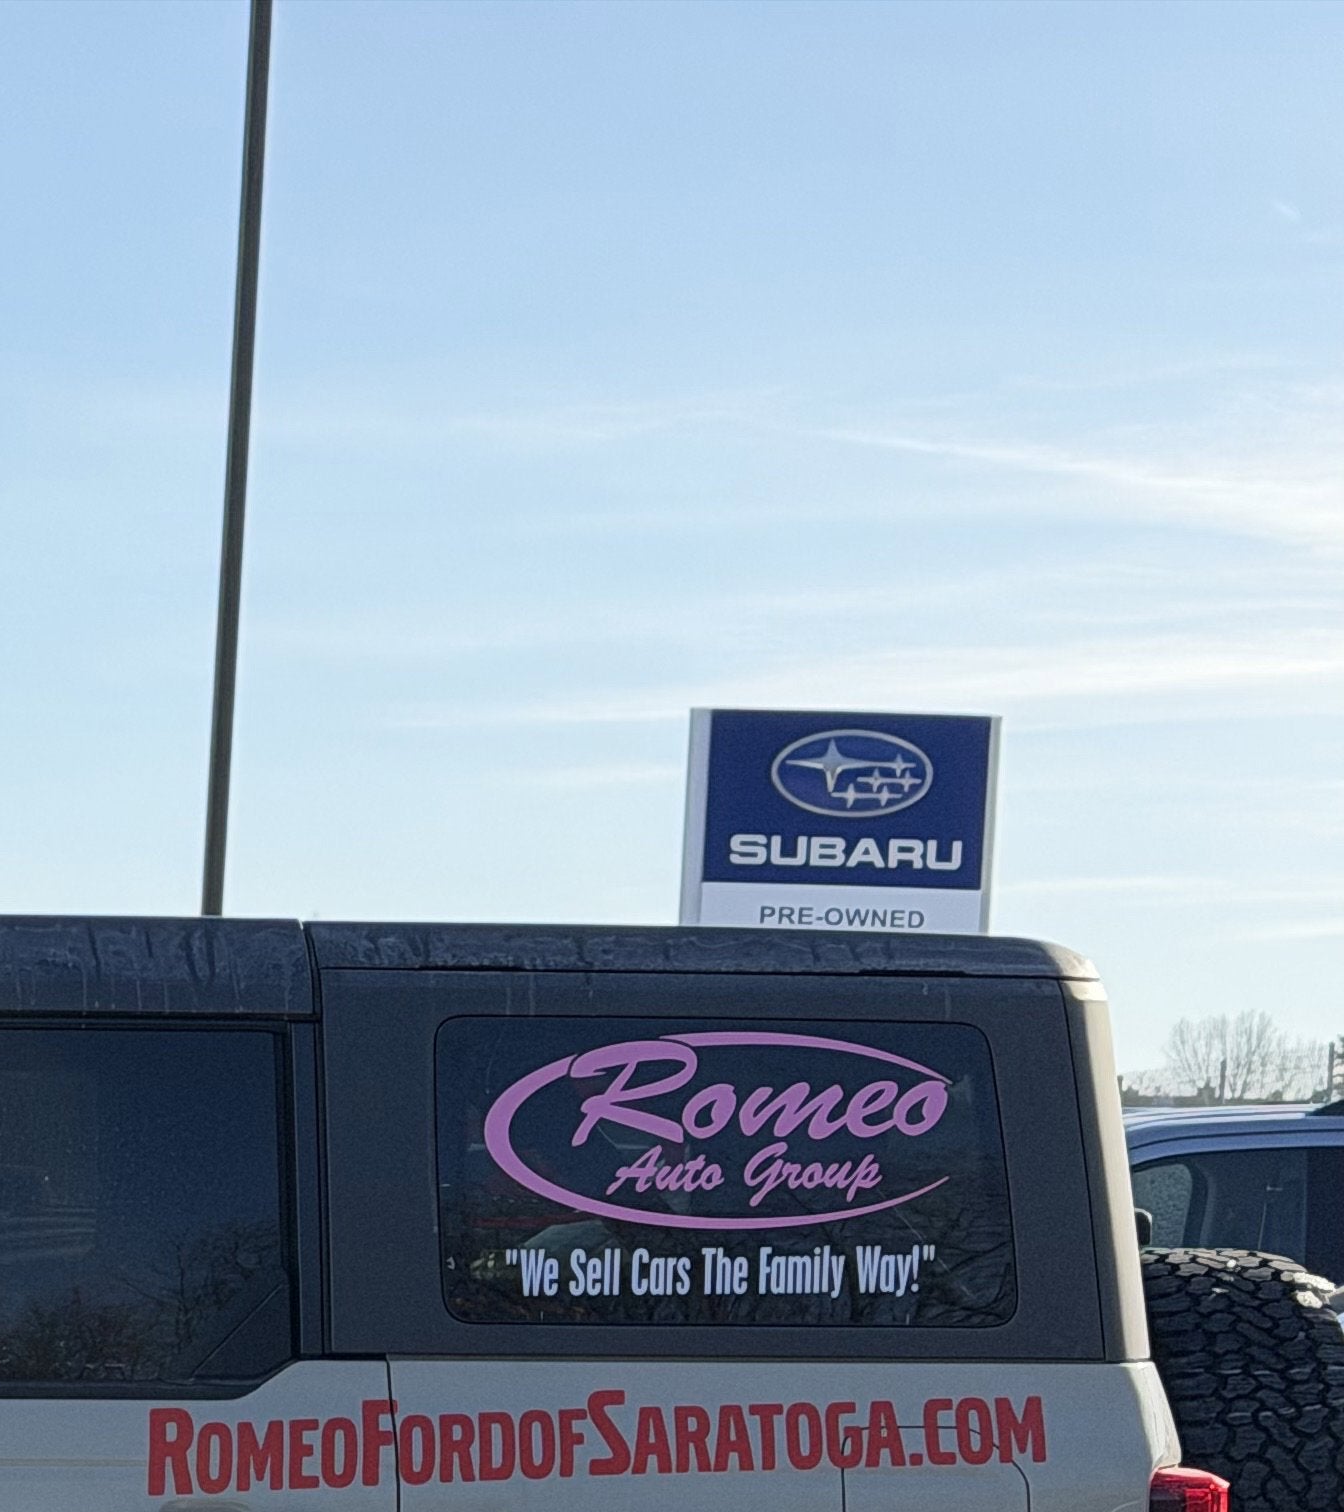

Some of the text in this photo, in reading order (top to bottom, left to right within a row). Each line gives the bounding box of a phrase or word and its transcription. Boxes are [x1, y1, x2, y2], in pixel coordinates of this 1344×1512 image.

[729, 834, 963, 871] SUBARU
[759, 906, 925, 929] PRE-OWNED
[569, 1040, 949, 1147] Romeo
[606, 1142, 882, 1206] Auto Group
[505, 1244, 936, 1299] "We Sell Cars The Family Way!"
